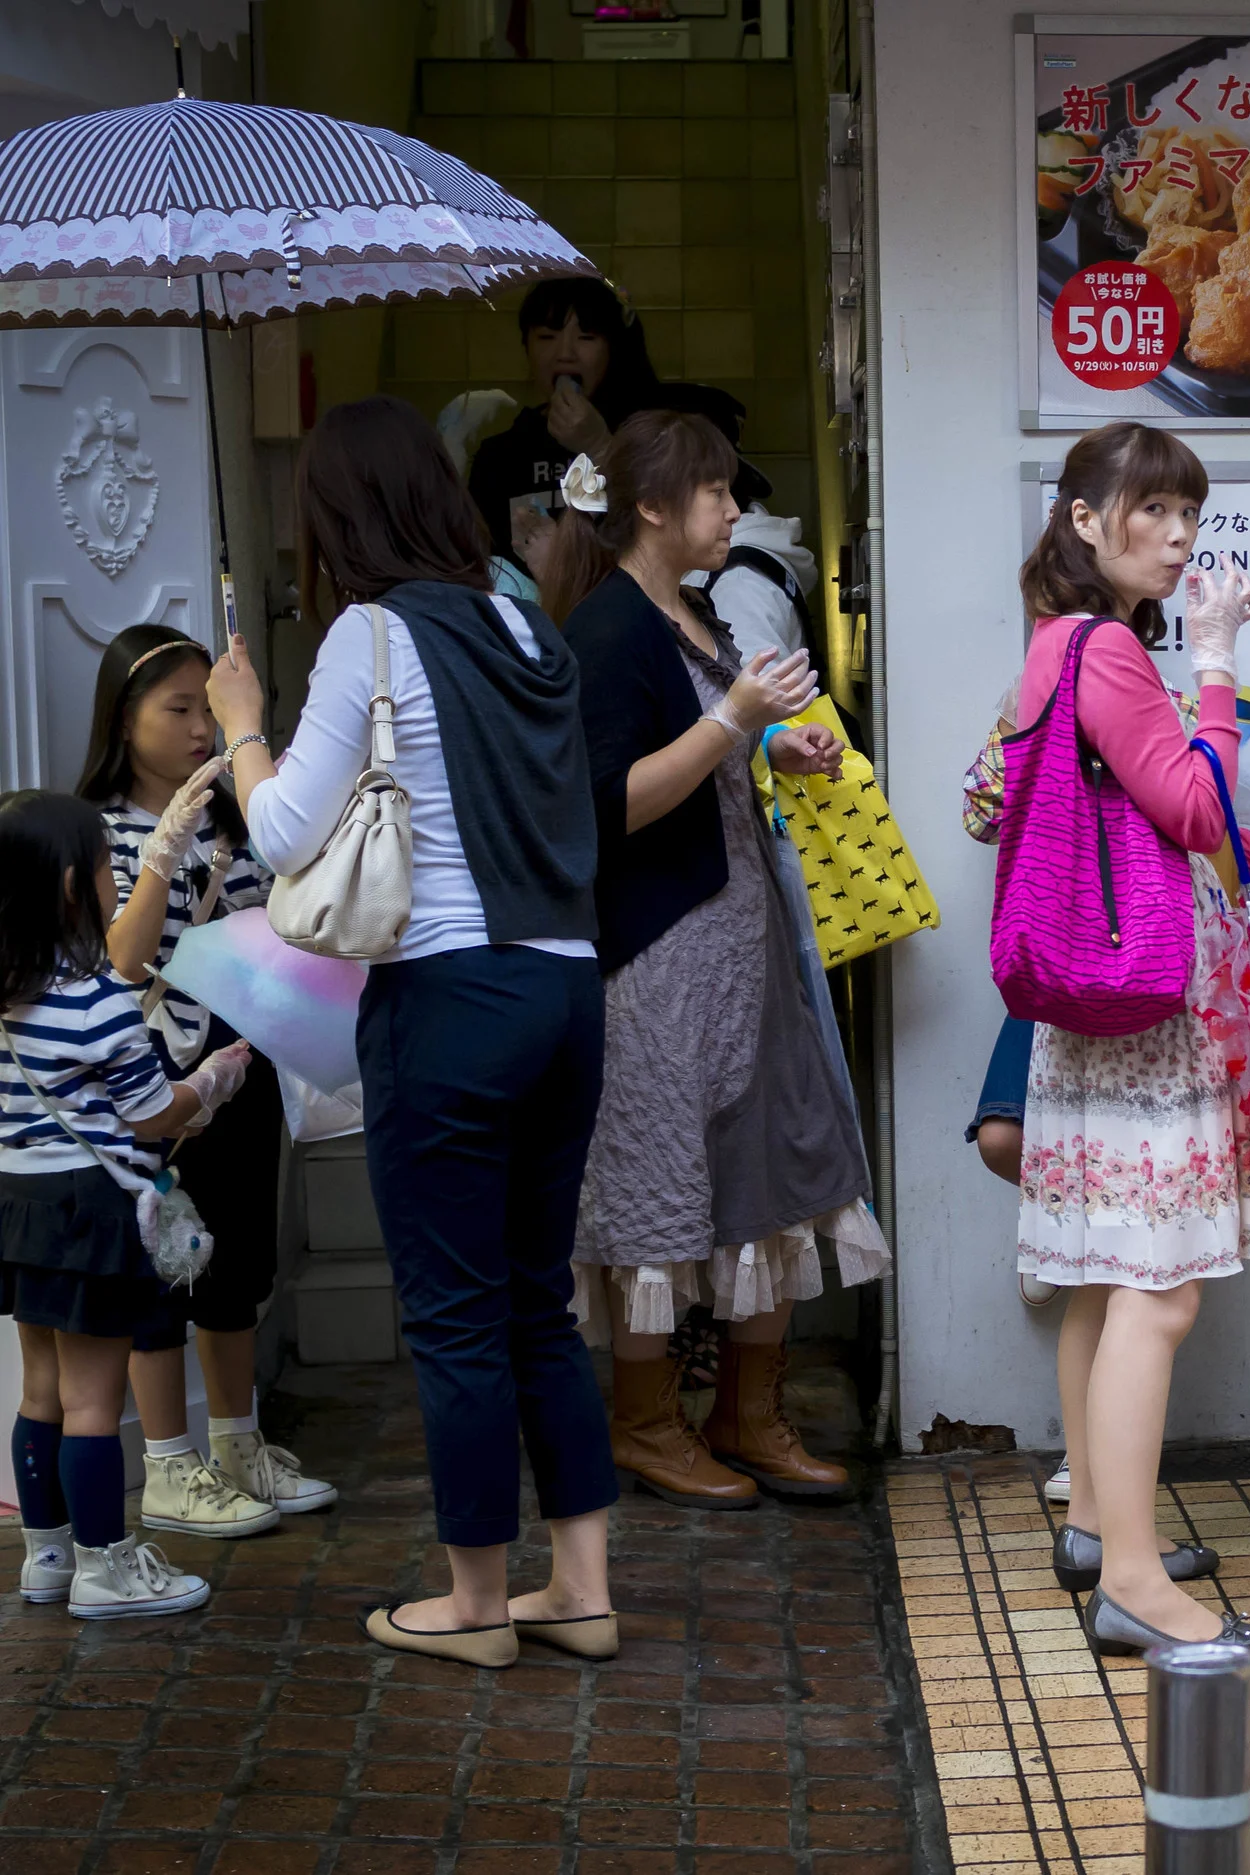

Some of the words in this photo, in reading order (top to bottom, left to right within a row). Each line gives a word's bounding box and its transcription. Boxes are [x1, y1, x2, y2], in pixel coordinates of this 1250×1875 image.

[1084, 272, 1147, 285] お試し価格
[533, 459, 574, 484] Re
